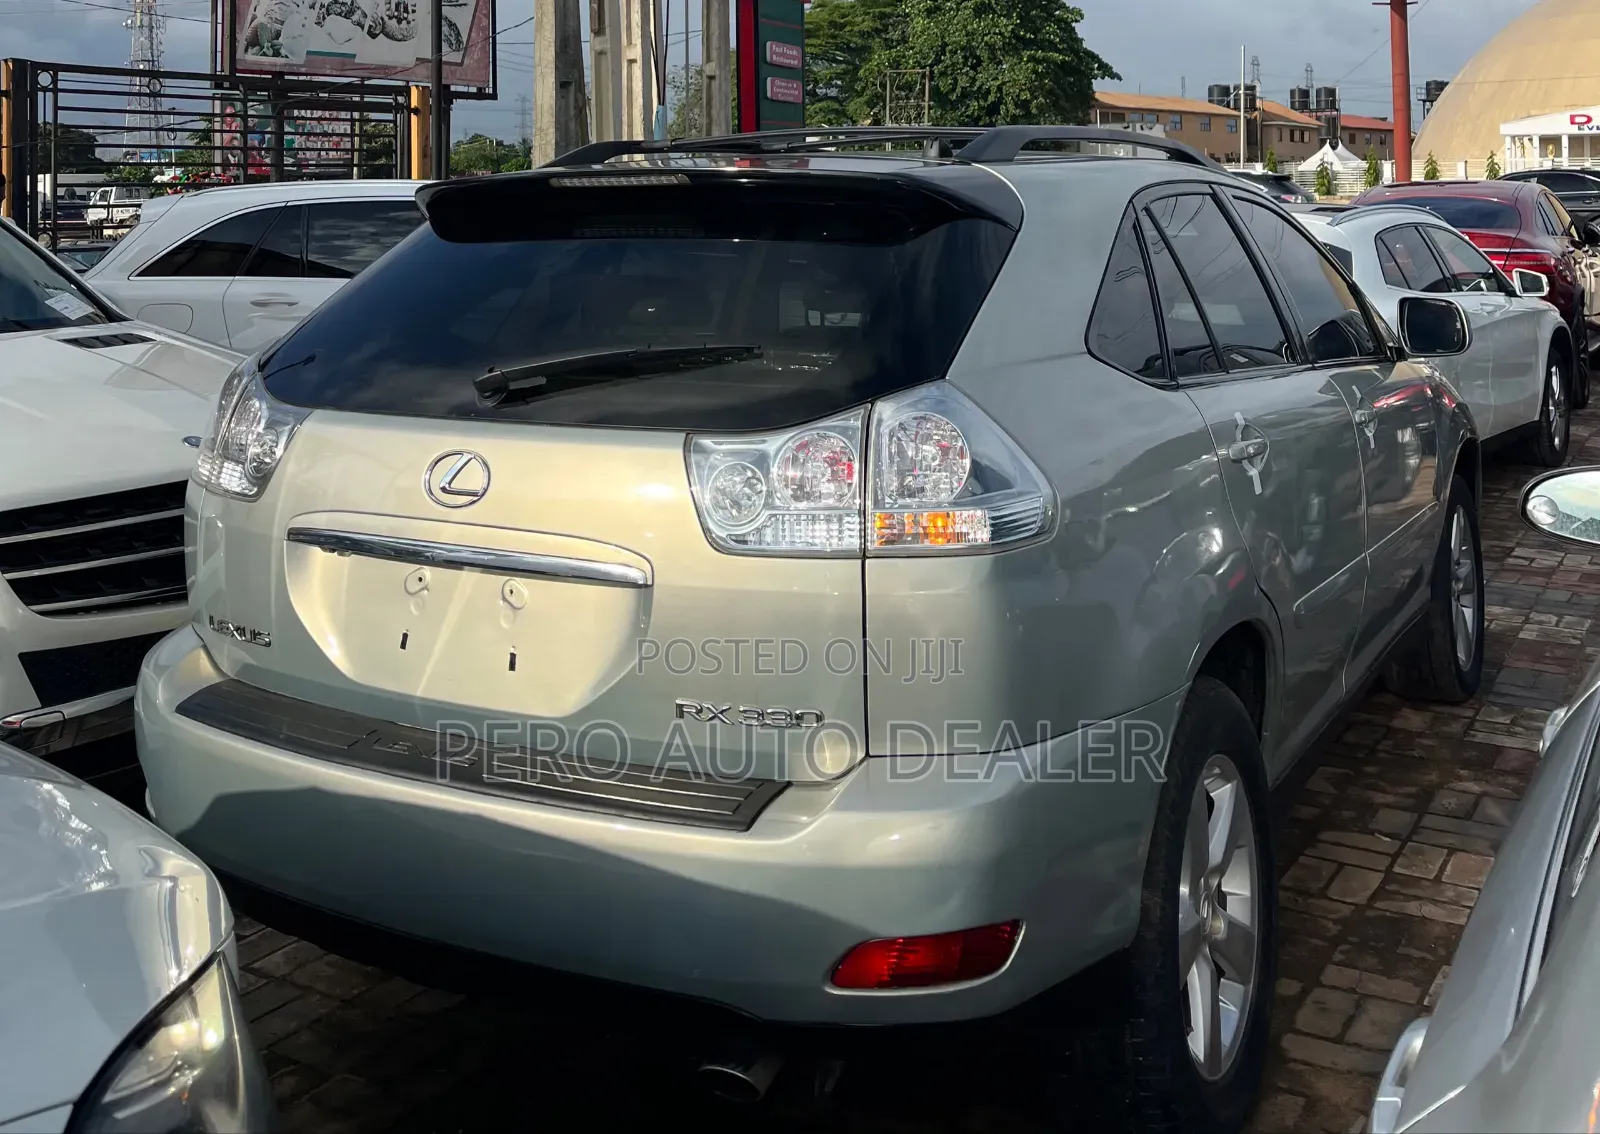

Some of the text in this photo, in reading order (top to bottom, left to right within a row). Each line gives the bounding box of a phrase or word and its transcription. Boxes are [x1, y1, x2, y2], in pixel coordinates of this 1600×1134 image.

[773, 55, 798, 65] Restaurant
[208, 614, 272, 648] LEXUS
[675, 697, 826, 729] RX 330
